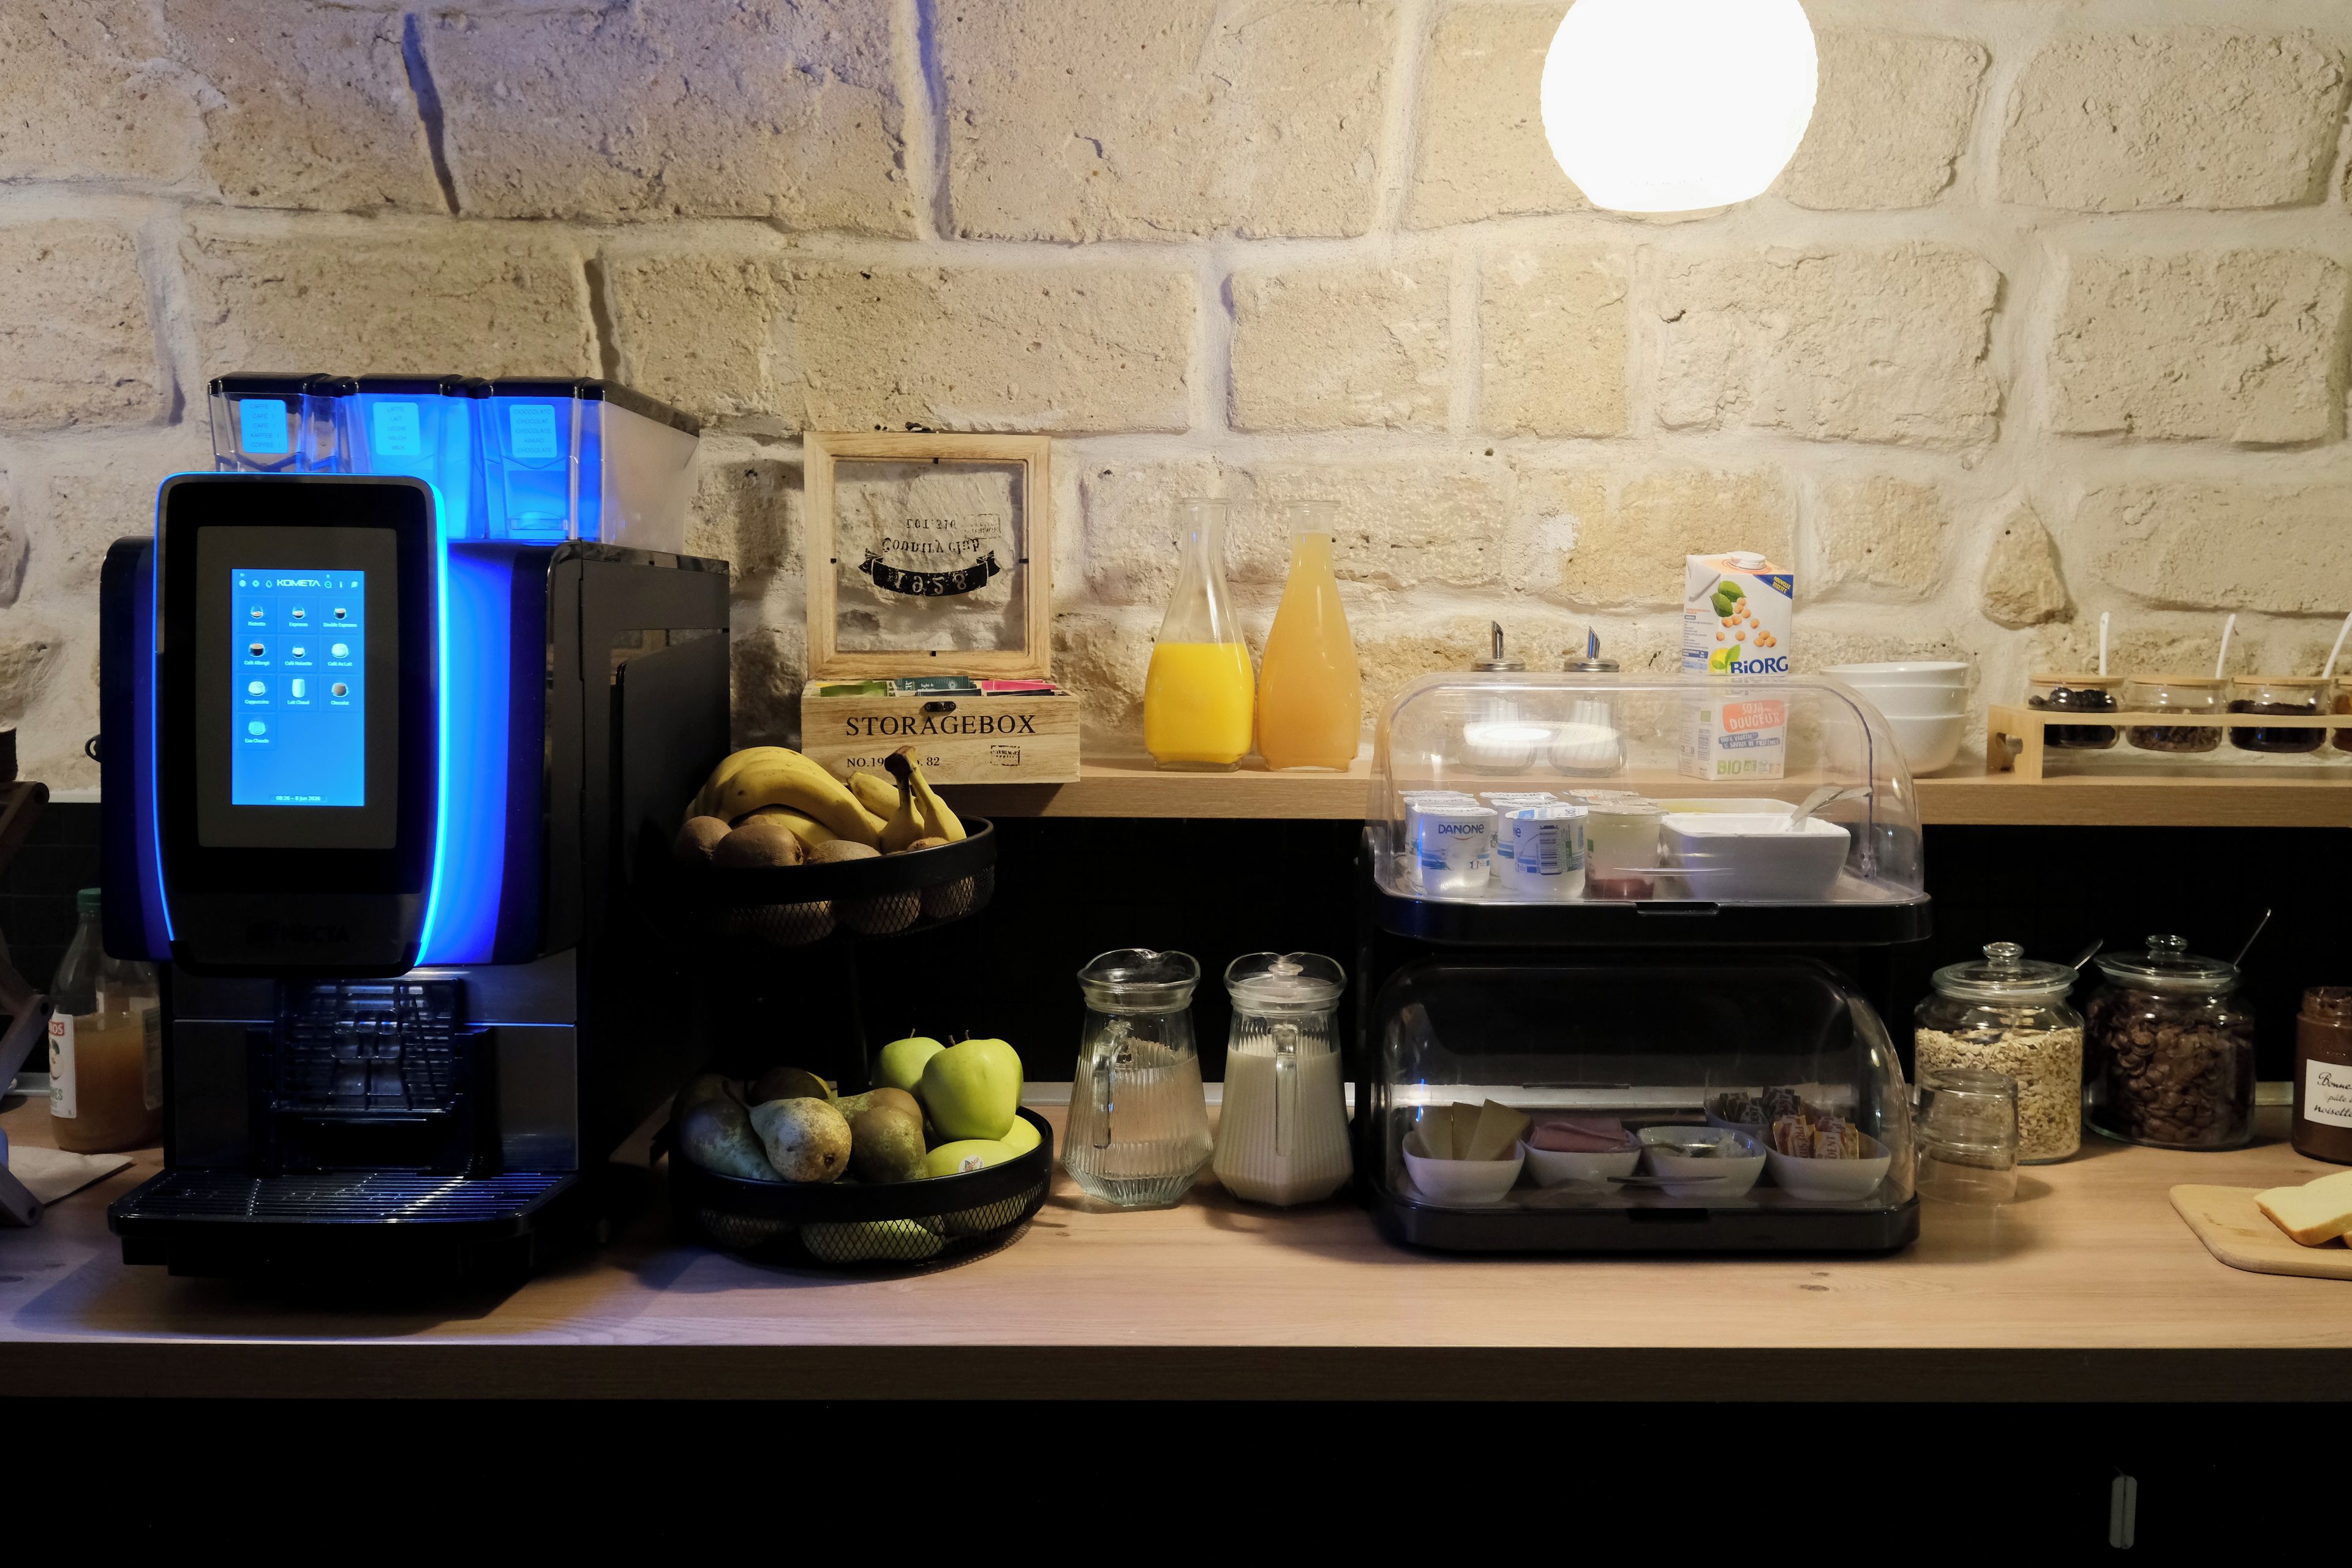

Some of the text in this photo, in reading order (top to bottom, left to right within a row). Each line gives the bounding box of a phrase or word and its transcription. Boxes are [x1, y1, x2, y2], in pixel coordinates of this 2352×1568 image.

[276, 579, 322, 587] KOMETA
[1742, 702, 1764, 715] SOJA
[845, 714, 1036, 736] STORAGEBOX
[1728, 712, 1780, 731] DOUCEUR
[926, 756, 940, 767] 82
[1717, 760, 1742, 775] BIO
[282, 924, 349, 944] NECTA
